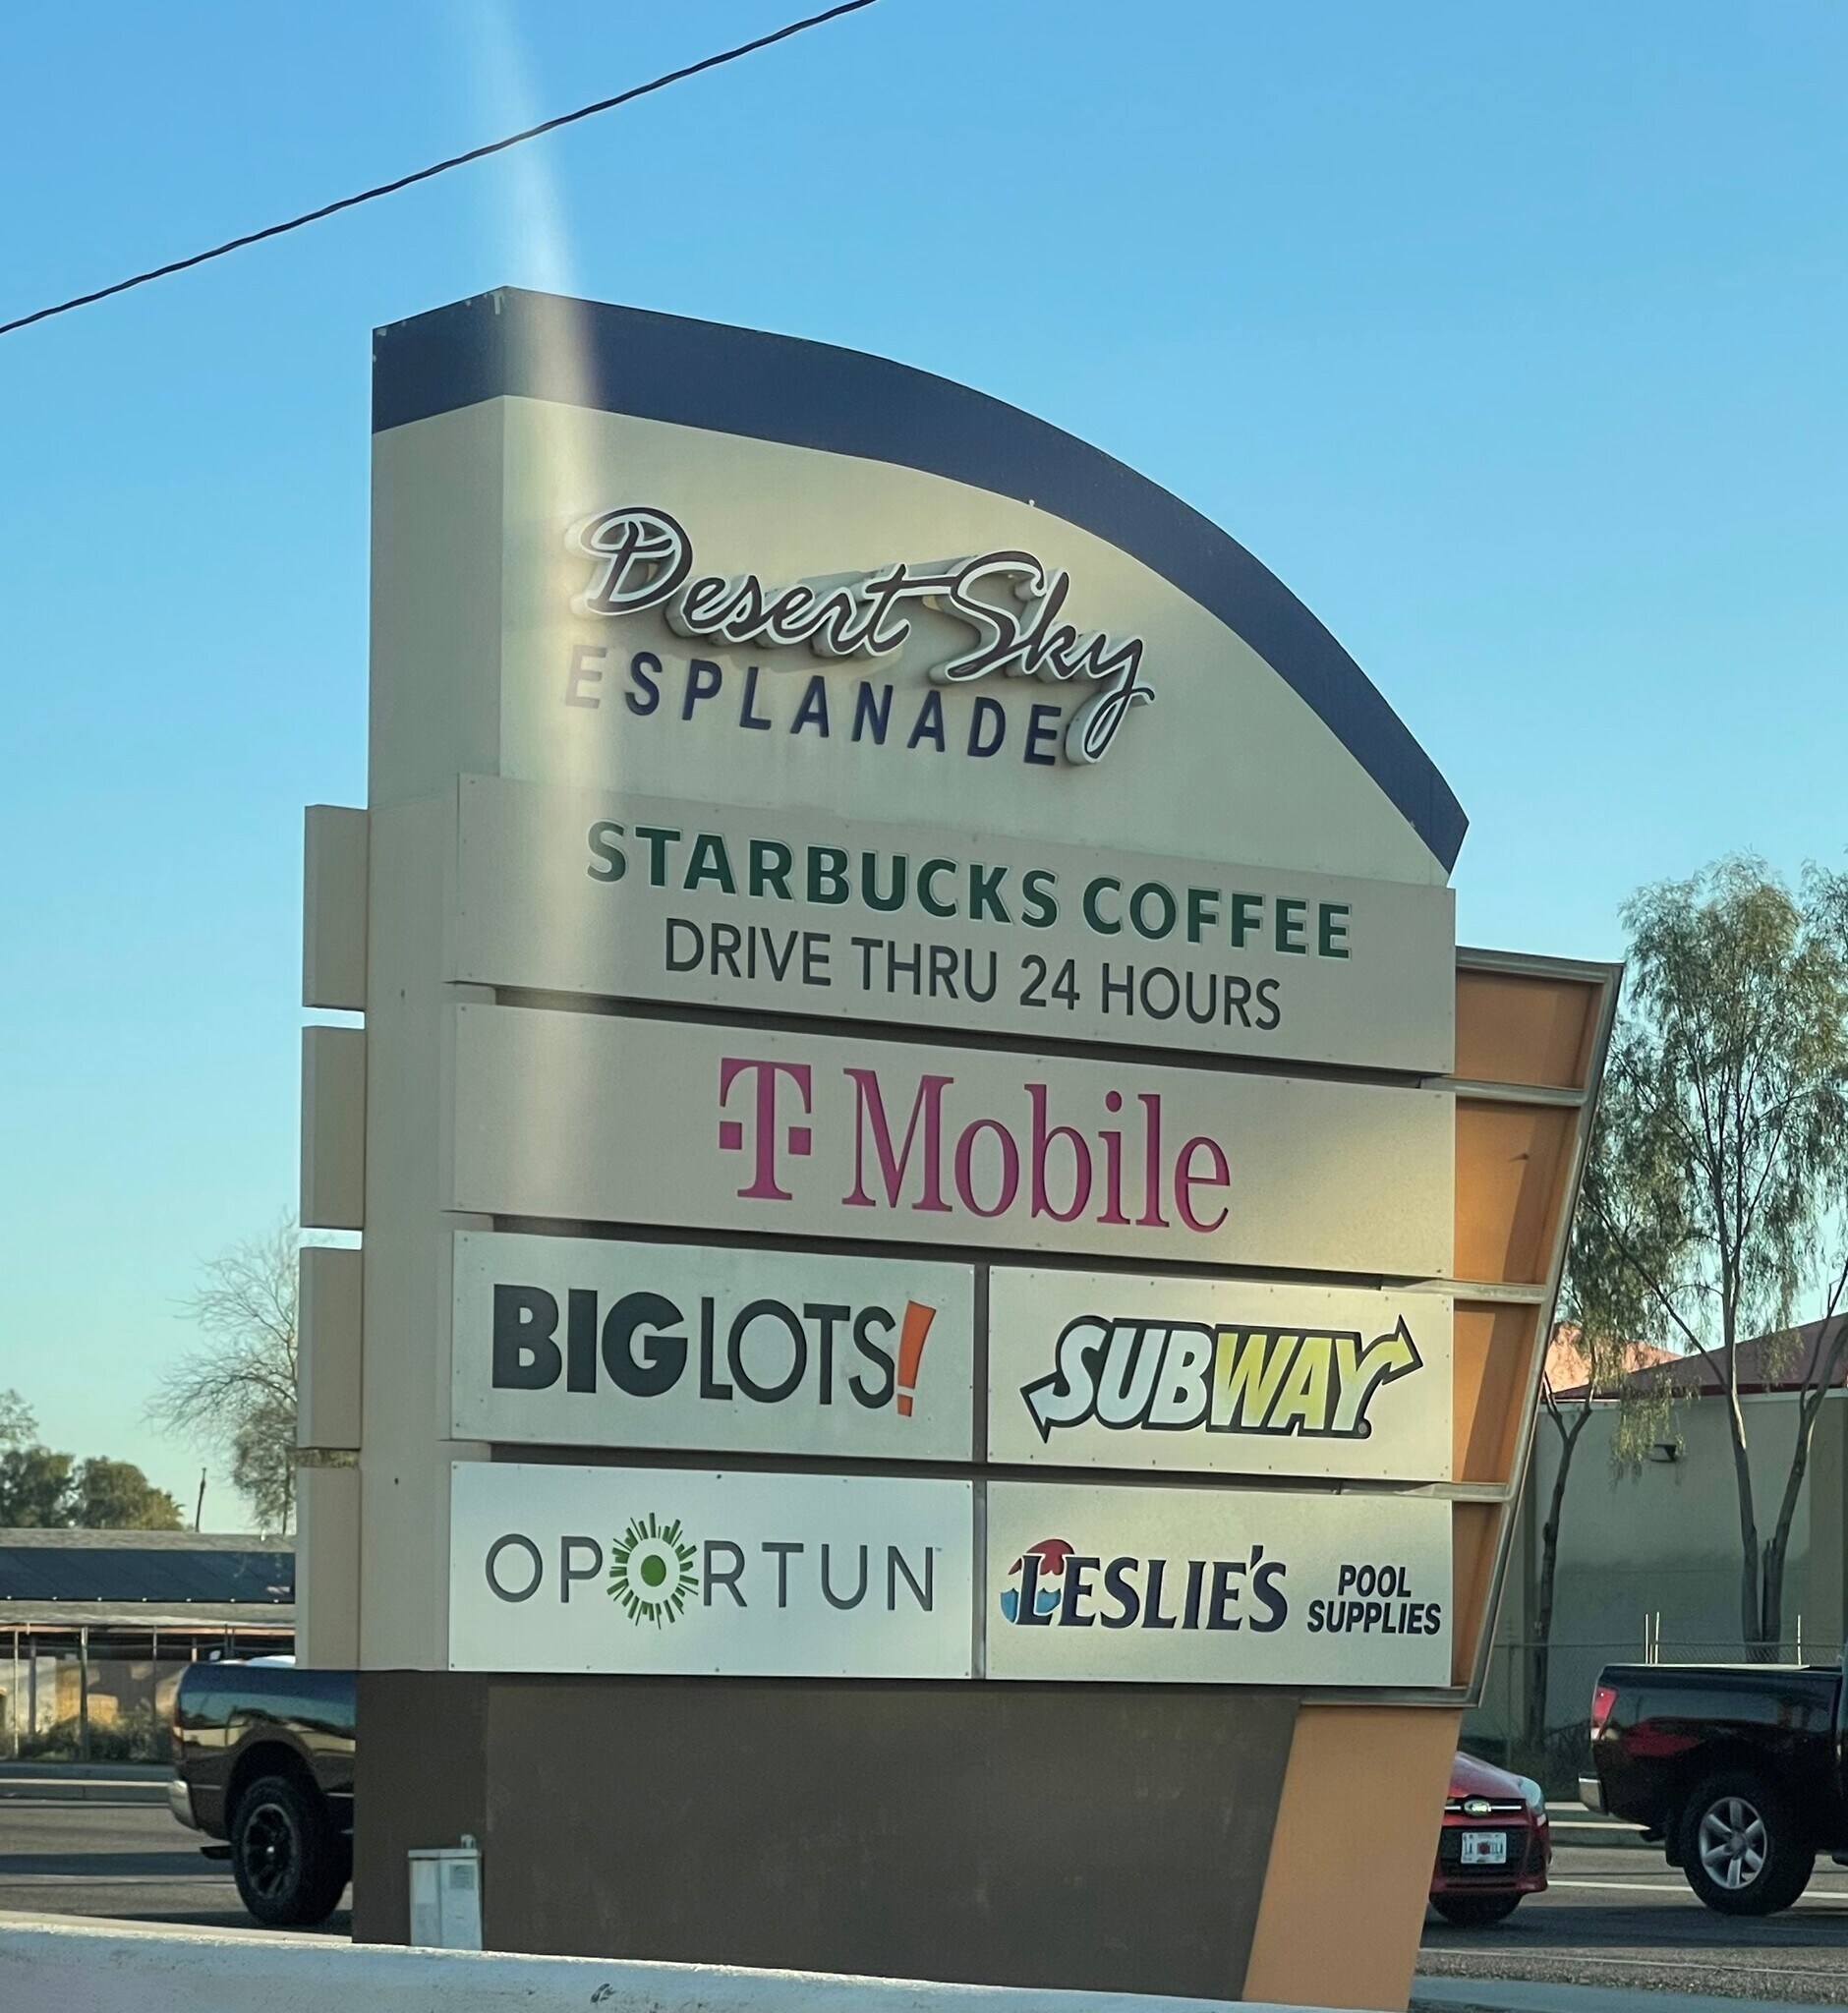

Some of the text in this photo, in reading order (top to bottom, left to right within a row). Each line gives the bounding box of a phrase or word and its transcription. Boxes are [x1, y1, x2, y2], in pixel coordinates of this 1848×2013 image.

[574, 506, 1156, 765] Desert Sky
[565, 645, 1063, 766] ESPLANADE
[586, 820, 1353, 960] STARBUCKS COFFEE
[664, 917, 1281, 1031] DRIVE THRU 24 HOURS
[1020, 1314, 1423, 1444] SUBWAY
[1015, 1544, 1289, 1633] LESLIE'S
[1306, 1599, 1442, 1636] SUPPLIES
[1337, 1564, 1413, 1599] POOL
